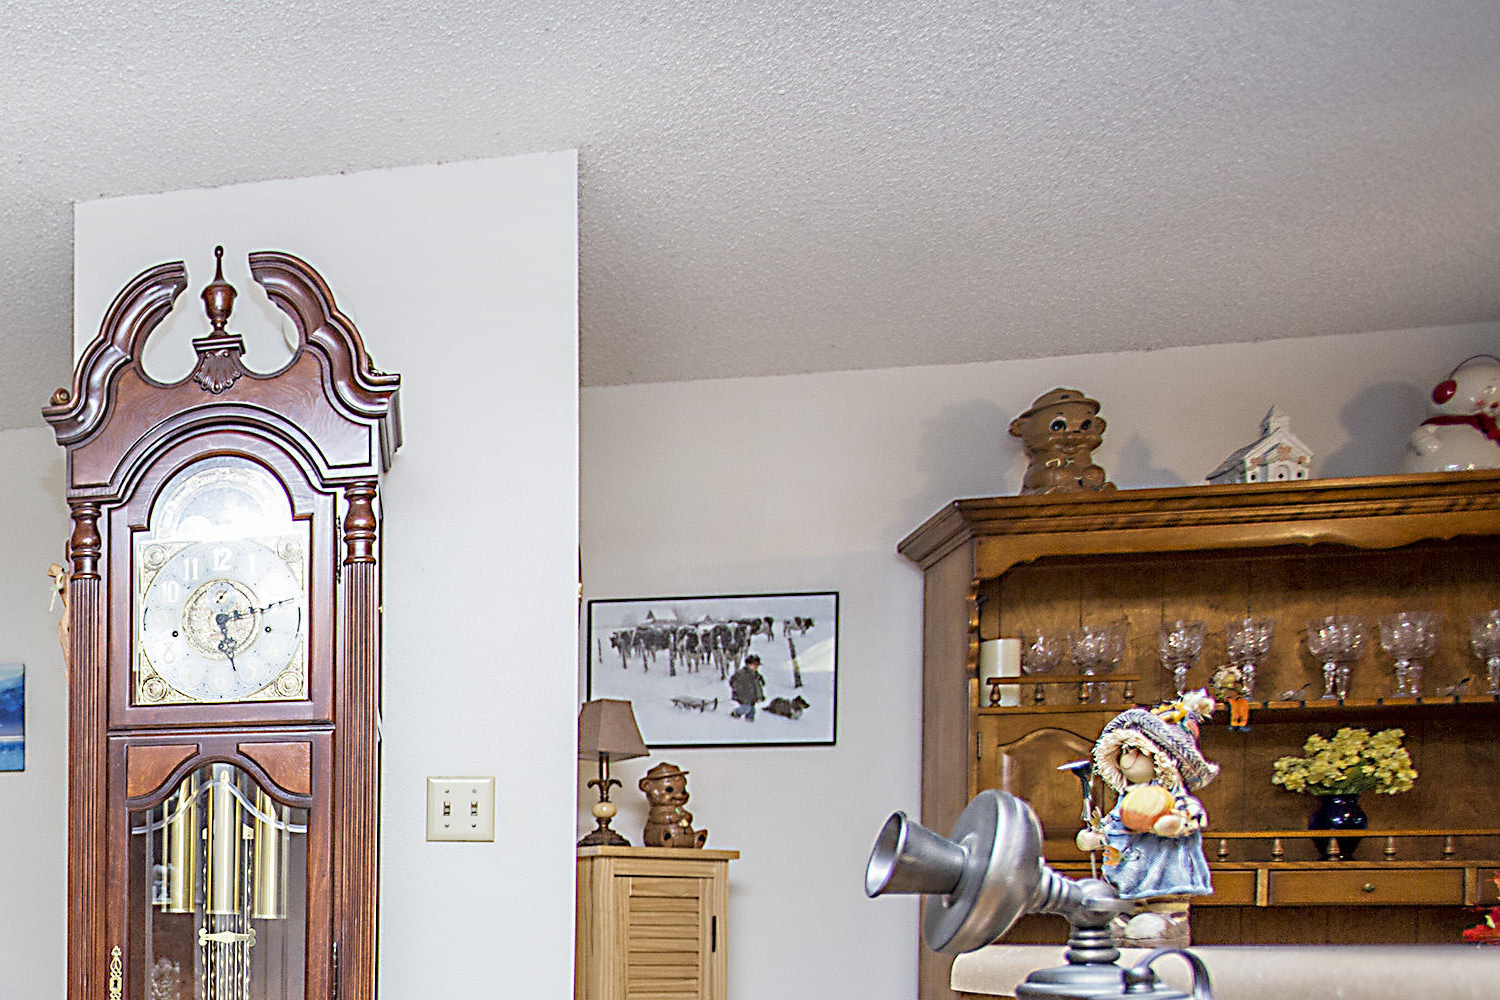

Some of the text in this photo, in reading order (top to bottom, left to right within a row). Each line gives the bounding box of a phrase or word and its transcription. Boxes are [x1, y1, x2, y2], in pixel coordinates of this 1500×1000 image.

[183, 557, 200, 581] 11
[211, 547, 233, 571] 12
[161, 580, 180, 603] 10
